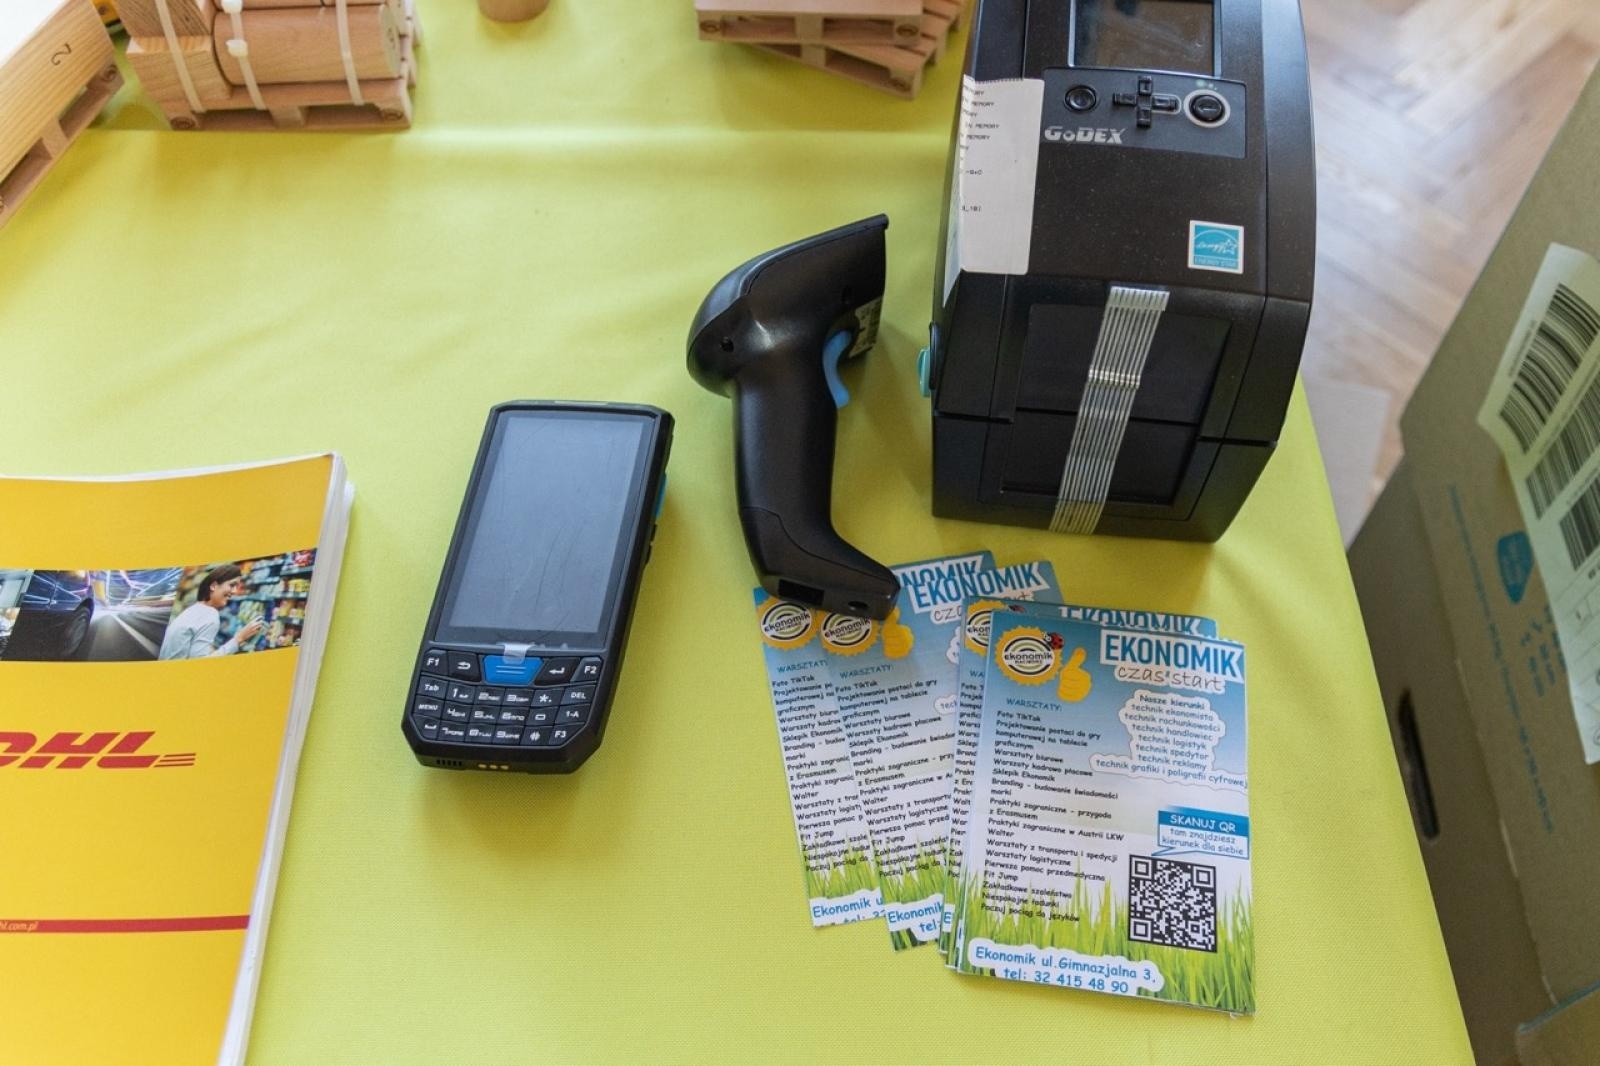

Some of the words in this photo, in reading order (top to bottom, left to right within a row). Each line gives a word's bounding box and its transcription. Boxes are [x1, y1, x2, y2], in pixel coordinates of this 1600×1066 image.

[913, 563, 1042, 609] EKONOMIK
[764, 611, 811, 633] ekonomik
[426, 657, 440, 667] F1
[1004, 651, 1054, 662] ekonomik
[1105, 634, 1238, 678] EKONOMIK
[584, 665, 598, 675] F2
[1117, 665, 1166, 684] czas
[1171, 670, 1223, 691] start
[424, 683, 440, 692] Tab
[570, 691, 586, 699] DEL
[418, 703, 439, 711] MENU
[1139, 694, 1167, 706] Nasze
[1170, 697, 1205, 711] kierunki
[997, 710, 1014, 719] Foto
[1016, 712, 1041, 722] TikTok
[1131, 703, 1164, 715] technik
[1166, 708, 1214, 722] ekonomista
[996, 719, 1046, 732] Projektowanie
[1048, 727, 1075, 737] postaci
[1076, 729, 1086, 737] do
[1088, 732, 1101, 741] gry
[1124, 711, 1157, 723] technik
[1158, 717, 1221, 733] rachunkowości
[554, 730, 567, 739] F3
[995, 729, 1046, 743] komputerowej
[1059, 738, 1088, 747] tablecie
[1132, 723, 1165, 734] technik
[1166, 725, 1213, 742] handlowiec
[994, 739, 1034, 750] graficznym
[1138, 733, 1171, 745] technik
[1173, 737, 1207, 751] logistyk
[994, 748, 1034, 760] Warsztaty
[1036, 753, 1064, 763] biurowe
[1135, 743, 1168, 755] technik
[1169, 748, 1210, 761] spedytor
[1031, 762, 1062, 773] kadrowo
[1064, 767, 1094, 777] płacowe
[1096, 759, 1129, 770] technik
[1131, 762, 1160, 775] grafiki
[1167, 768, 1207, 781] poligrafii
[1138, 753, 1171, 766] technik
[1172, 759, 1208, 772] reklamy
[991, 767, 1019, 778] Sklepik
[1021, 770, 1056, 782] Ekonomik
[990, 788, 1012, 796] marki
[991, 777, 1024, 789] Branding
[1034, 783, 1071, 794] budowanie
[989, 797, 1021, 808] Praktyki
[1024, 802, 1067, 814] zagraniczne
[1077, 809, 1112, 820] przygoda
[996, 808, 1039, 820] Erasmusem
[987, 827, 1015, 838] Walter
[988, 817, 1020, 828] Praktyki
[1022, 822, 1066, 834] zagraniczne
[1078, 829, 1104, 839] Austrii
[1106, 832, 1125, 841] LKW
[1169, 814, 1216, 830] SKANUJ
[1219, 821, 1236, 833] QR
[1162, 834, 1200, 848] kierunek
[1202, 841, 1216, 851] dla
[1218, 844, 1244, 856] siebie
[1170, 827, 1187, 838] tam
[1189, 829, 1237, 845] znajdziesz
[985, 848, 1027, 861] Warsztaty
[1029, 854, 1072, 867] logistyczne
[986, 838, 1029, 851] Warsztaty
[1038, 845, 1079, 857] transportu
[1086, 851, 1118, 863] spedycji
[983, 869, 995, 879] Fit
[998, 871, 1019, 882] Jump
[984, 859, 1018, 871] Pierwsza
[1020, 864, 1044, 873] pomoc
[1046, 868, 1106, 882] przedmedyczna
[812, 897, 871, 918] Ekonomik
[888, 901, 944, 924] Ekonomik
[974, 945, 1037, 966] Ekonomik
[1003, 967, 1027, 980] tel:
[1034, 970, 1050, 982] 32
[1056, 973, 1083, 987] 415
[1088, 977, 1105, 991] 48
[1110, 980, 1129, 993] 90
